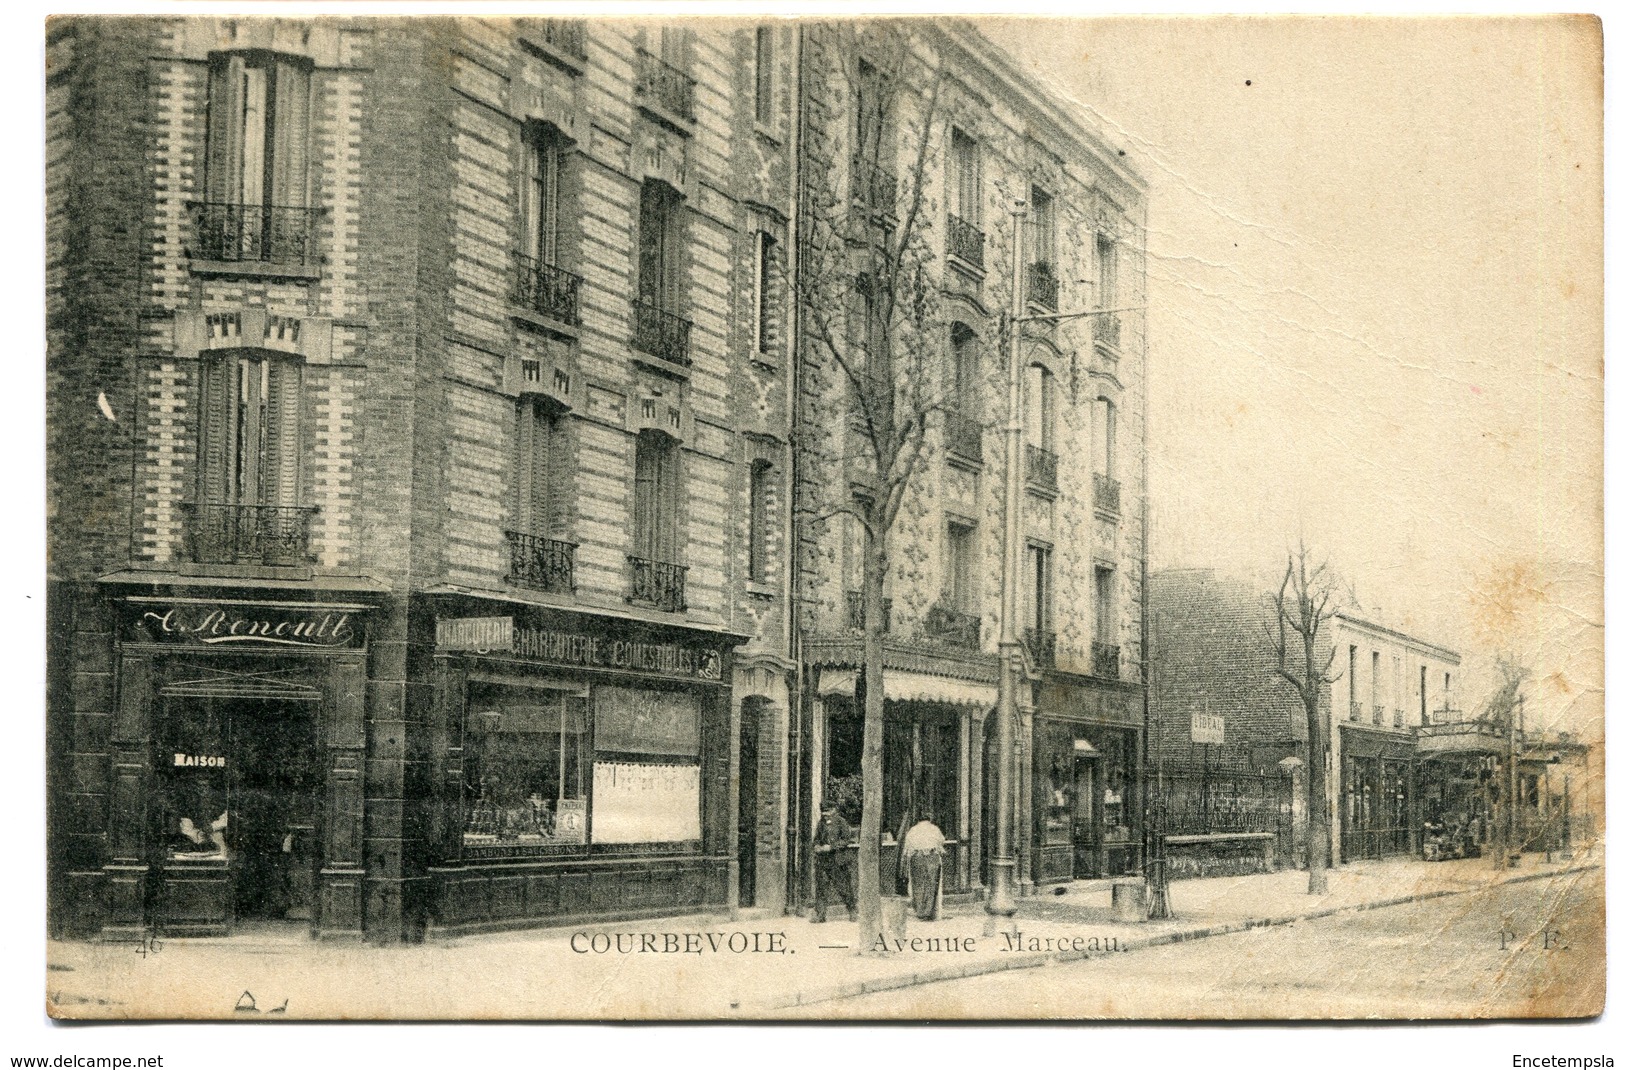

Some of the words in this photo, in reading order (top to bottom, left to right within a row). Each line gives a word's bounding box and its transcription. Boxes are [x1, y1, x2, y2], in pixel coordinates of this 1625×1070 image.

[436, 620, 513, 646] CHARCUTERIE
[512, 627, 601, 663] CHARCUTERIE
[174, 752, 226, 767] MAISON
